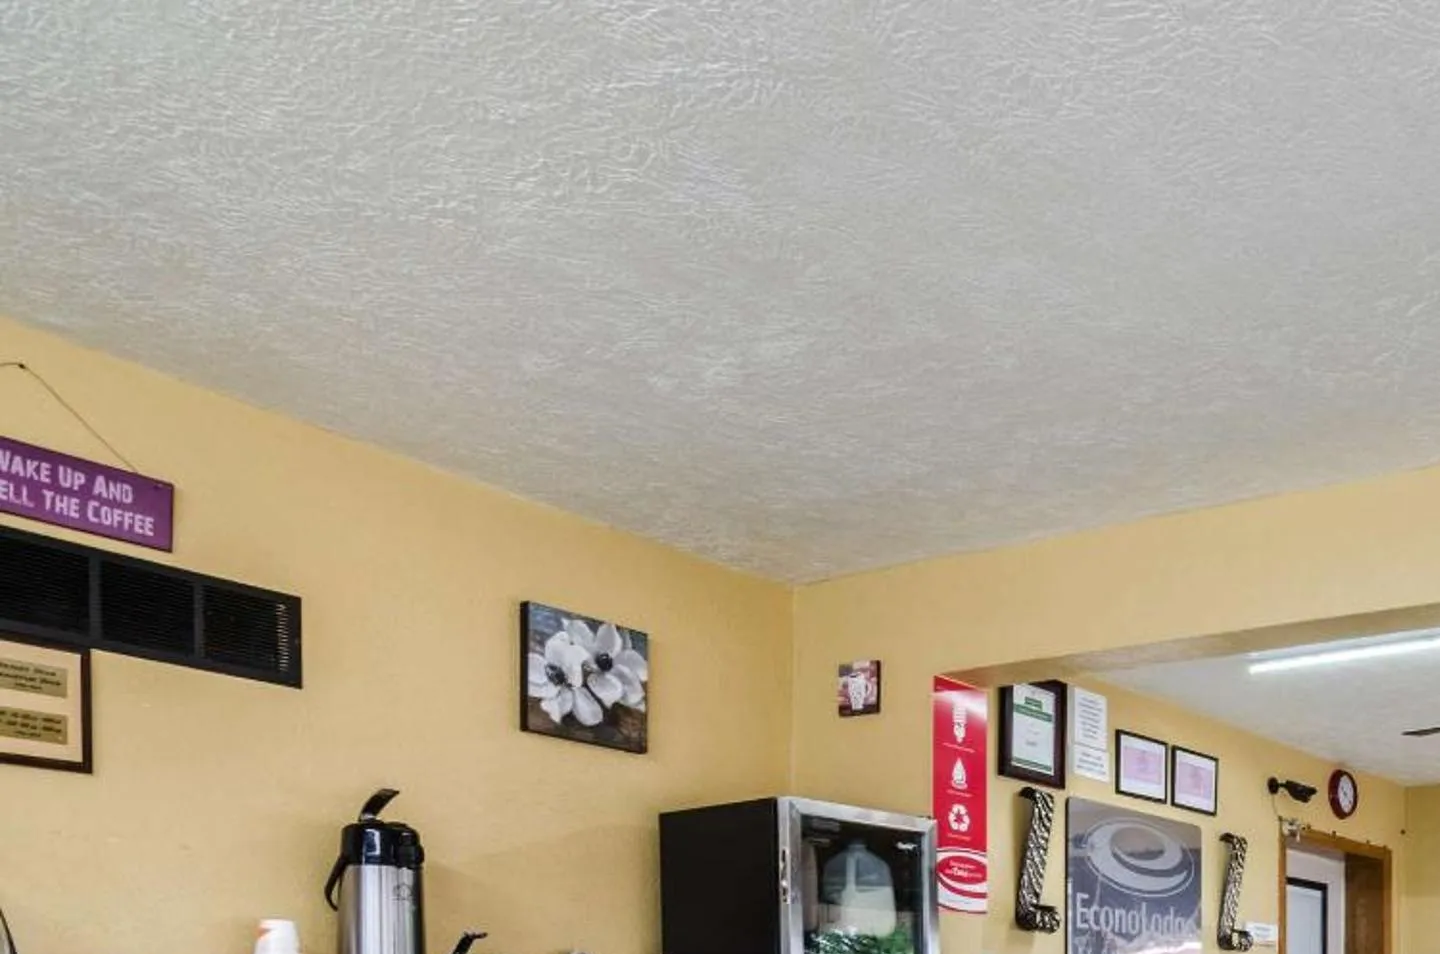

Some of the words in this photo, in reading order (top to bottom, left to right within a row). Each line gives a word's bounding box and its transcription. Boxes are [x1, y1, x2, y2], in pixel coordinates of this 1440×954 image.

[0, 449, 52, 483] WAKE
[58, 465, 86, 491] UP
[92, 475, 134, 504] AND
[42, 489, 81, 519] THE
[87, 499, 155, 537] COFFEE
